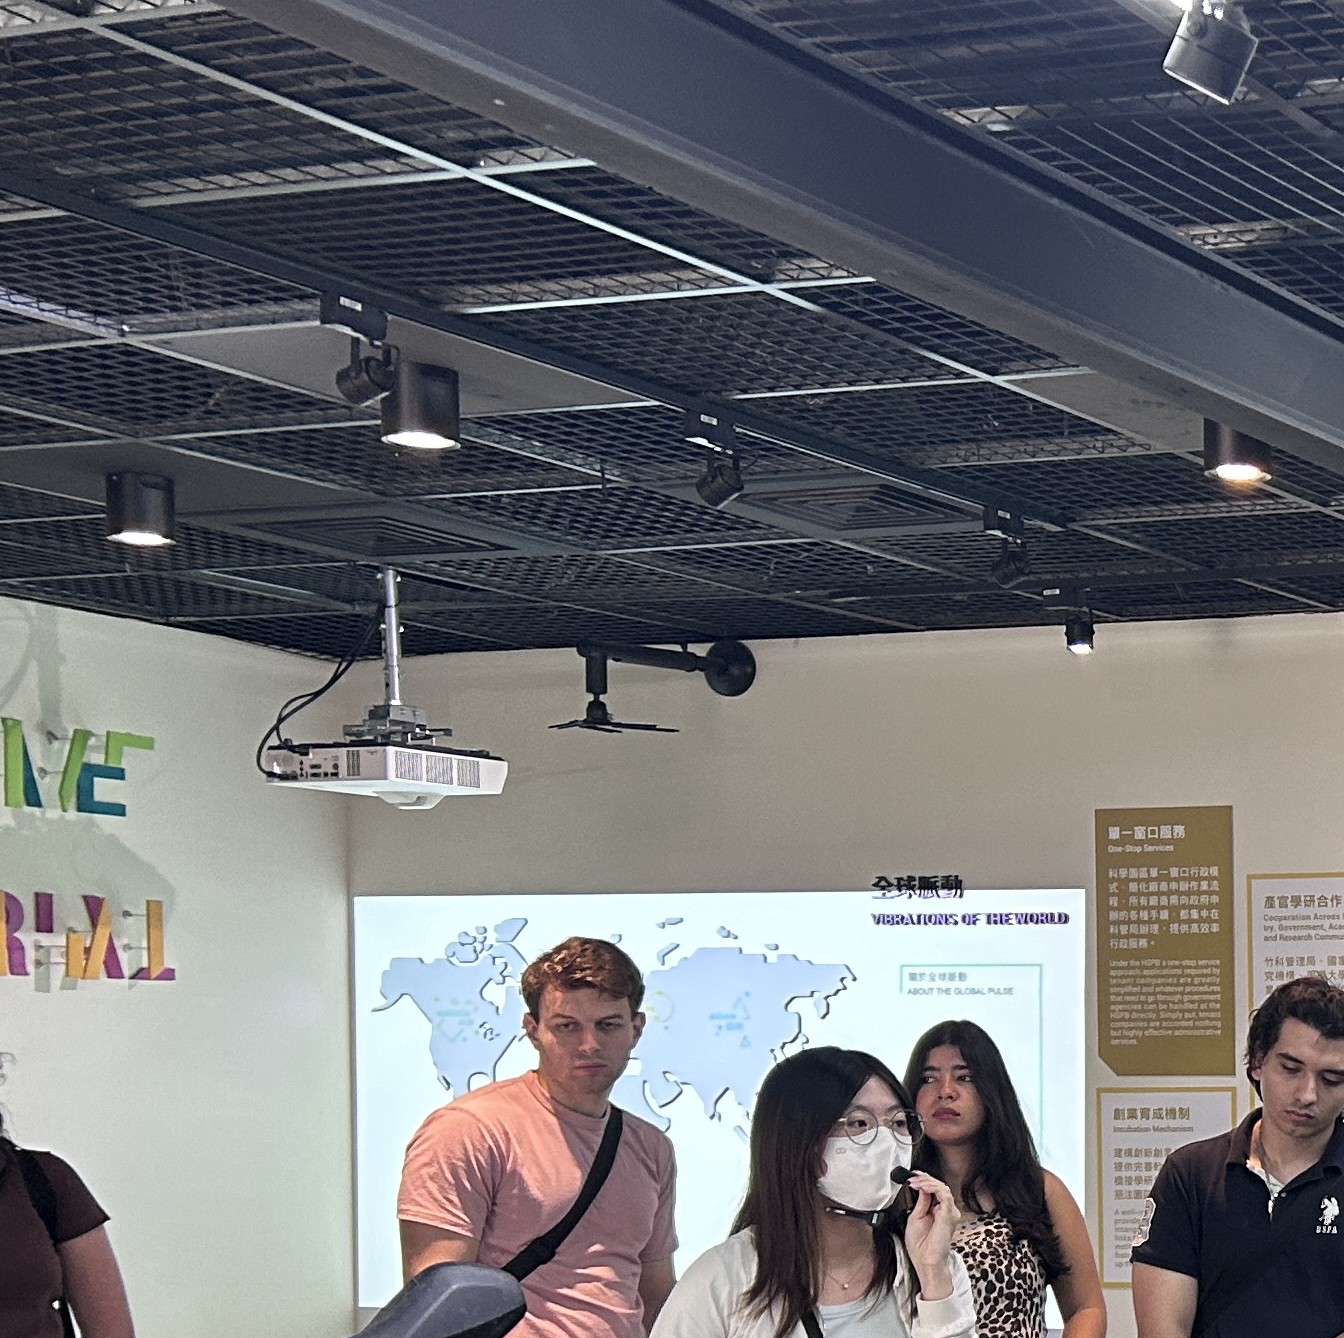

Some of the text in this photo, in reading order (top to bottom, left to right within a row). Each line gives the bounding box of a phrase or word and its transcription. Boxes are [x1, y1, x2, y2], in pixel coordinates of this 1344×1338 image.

[1108, 844, 1174, 853] One-Stop Services
[1264, 894, 1342, 909] 產官學研合作
[871, 912, 1070, 926] VIBRATIONS OF THE WORLD
[1263, 913, 1311, 922] Cooperation
[1313, 912, 1340, 921] Across
[1279, 933, 1313, 941] Research
[907, 986, 1014, 996] ABOUT THE GLOBAL PULSE
[1113, 1107, 1190, 1121] 創業育成機制
